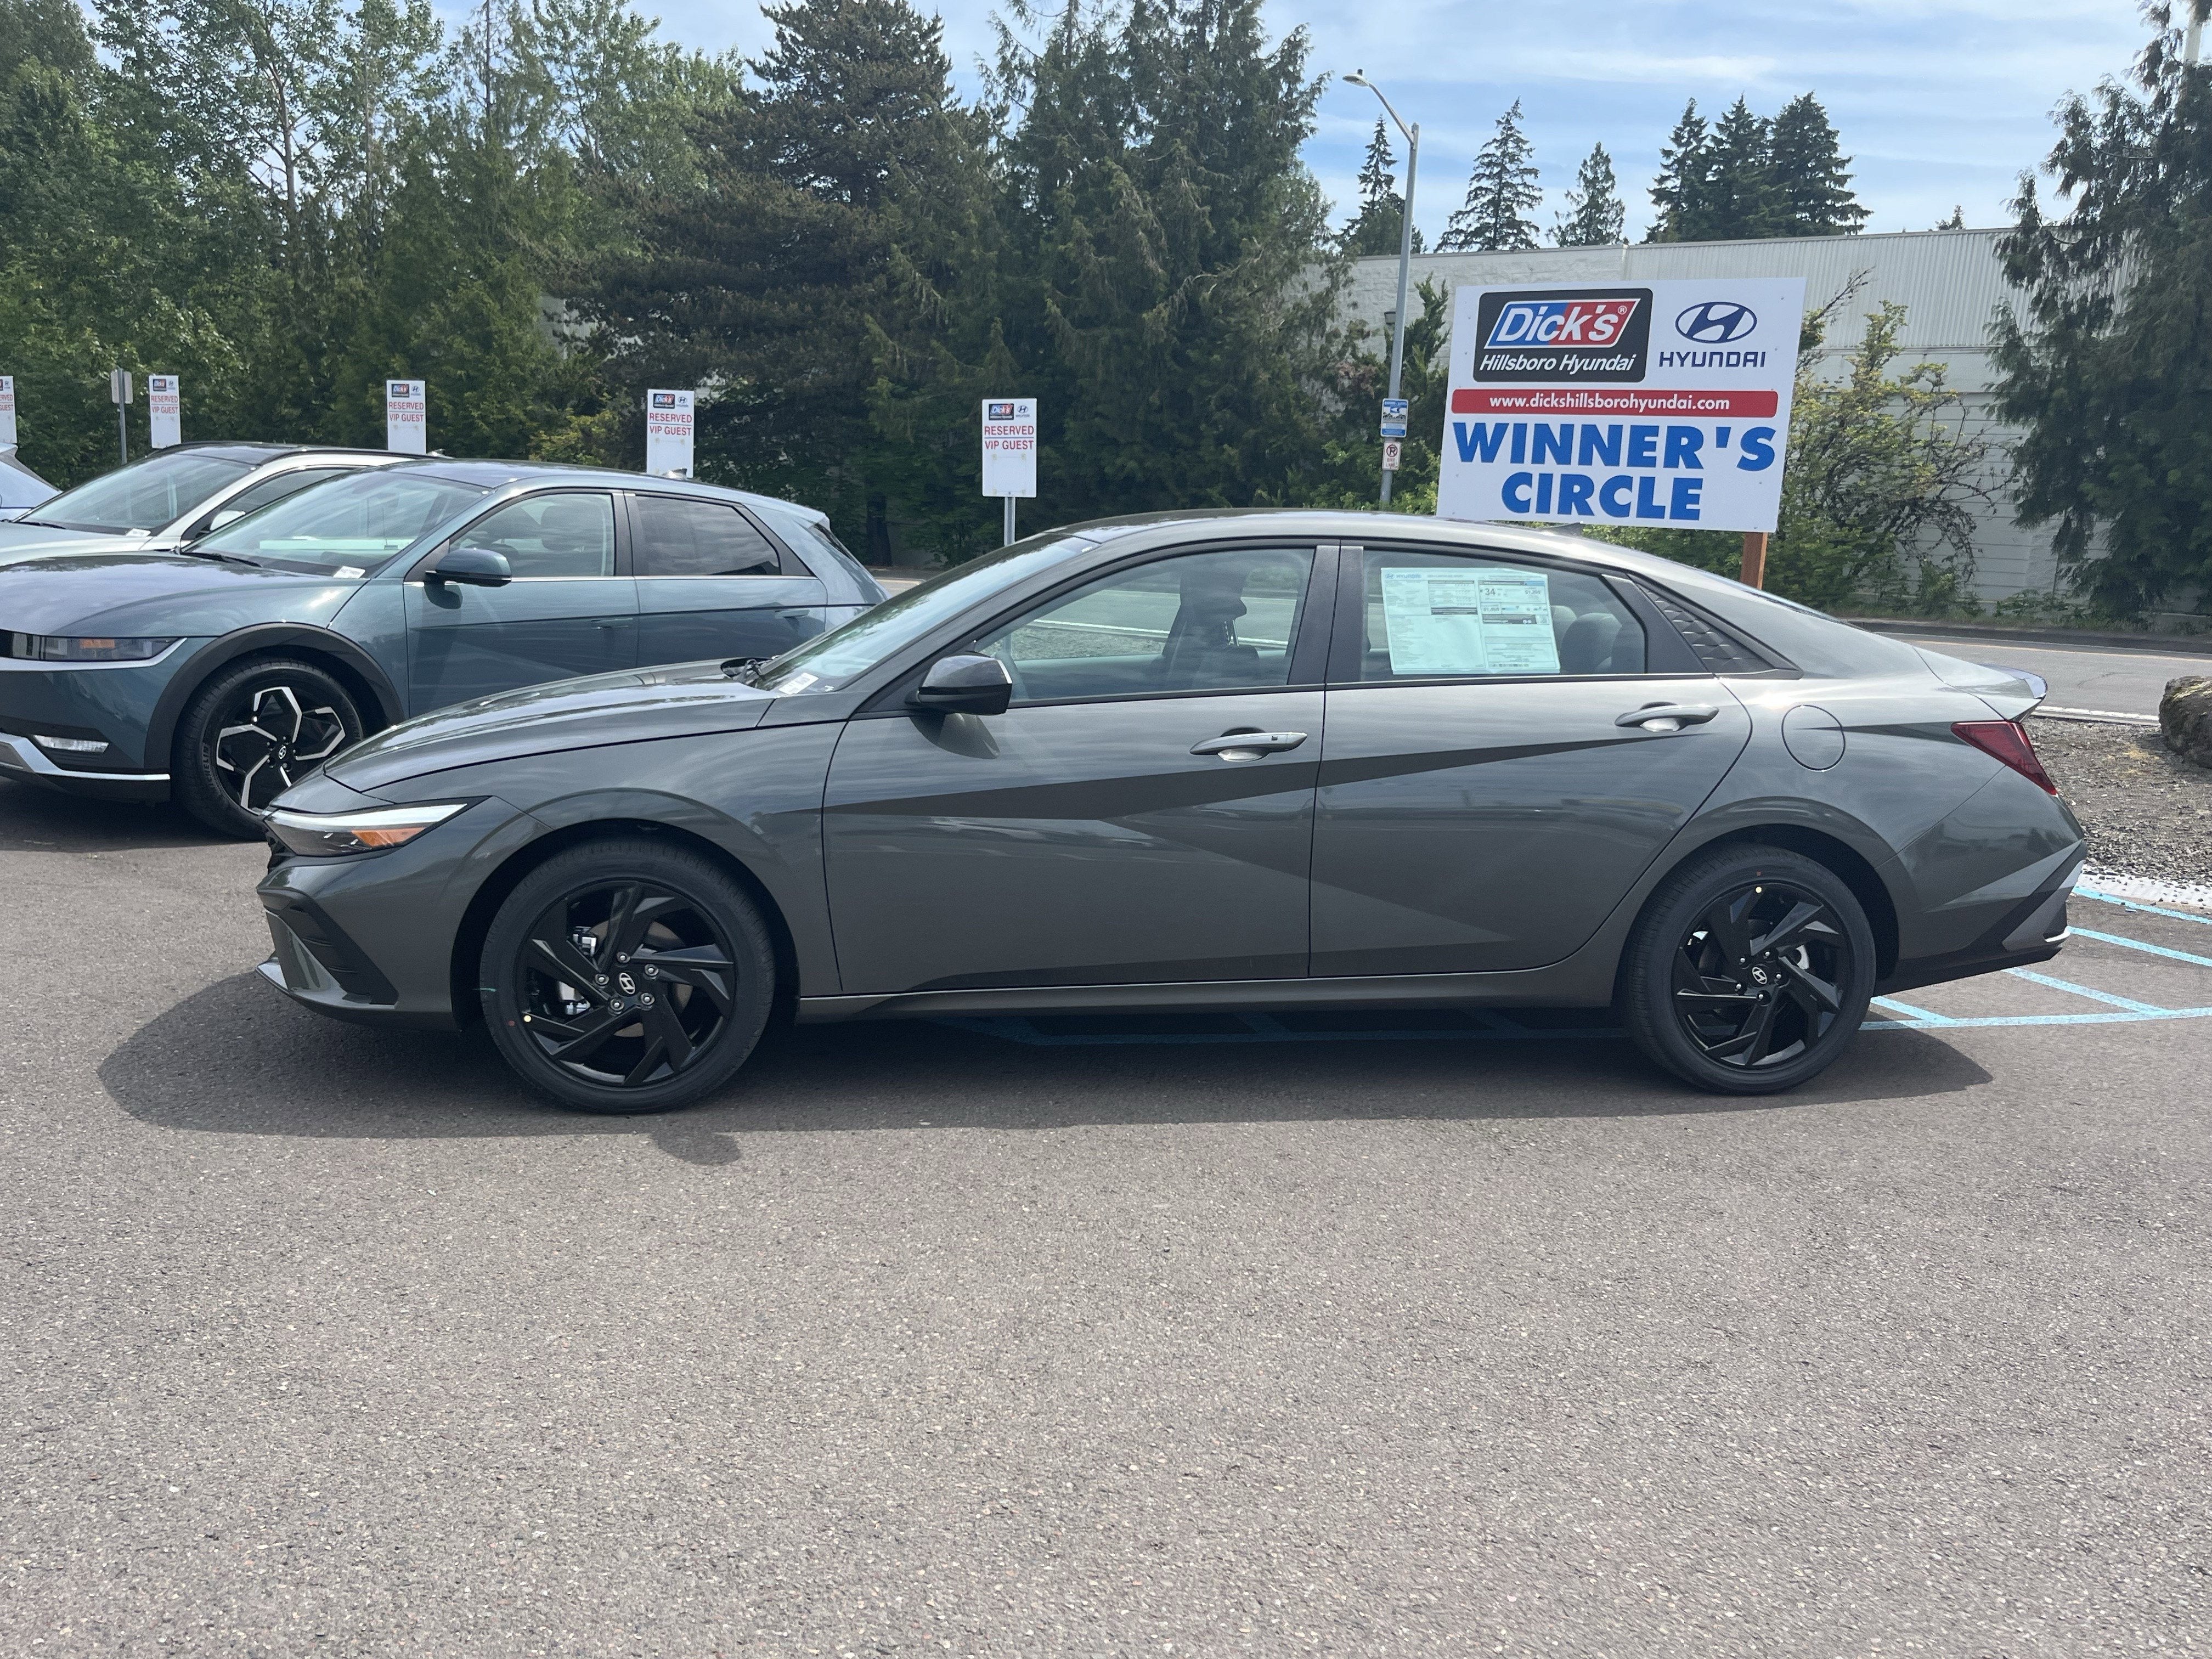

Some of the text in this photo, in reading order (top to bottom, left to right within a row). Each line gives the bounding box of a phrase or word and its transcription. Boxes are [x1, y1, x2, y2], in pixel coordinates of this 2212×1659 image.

[1480, 354, 1637, 375] Hillsboro Hyundai
[1658, 351, 1766, 368] HYUNDAI
[389, 402, 424, 410] RESERVED
[1490, 393, 1729, 412] www.dickshillsborohyundai.com
[650, 413, 692, 423] RESERVED
[650, 426, 691, 436] VIP GUEST
[985, 426, 1034, 435] RESERVED
[985, 441, 1034, 449] VIP GUEST
[1453, 422, 1776, 471] WINNER'S
[1501, 472, 1703, 521] CIRCLE
